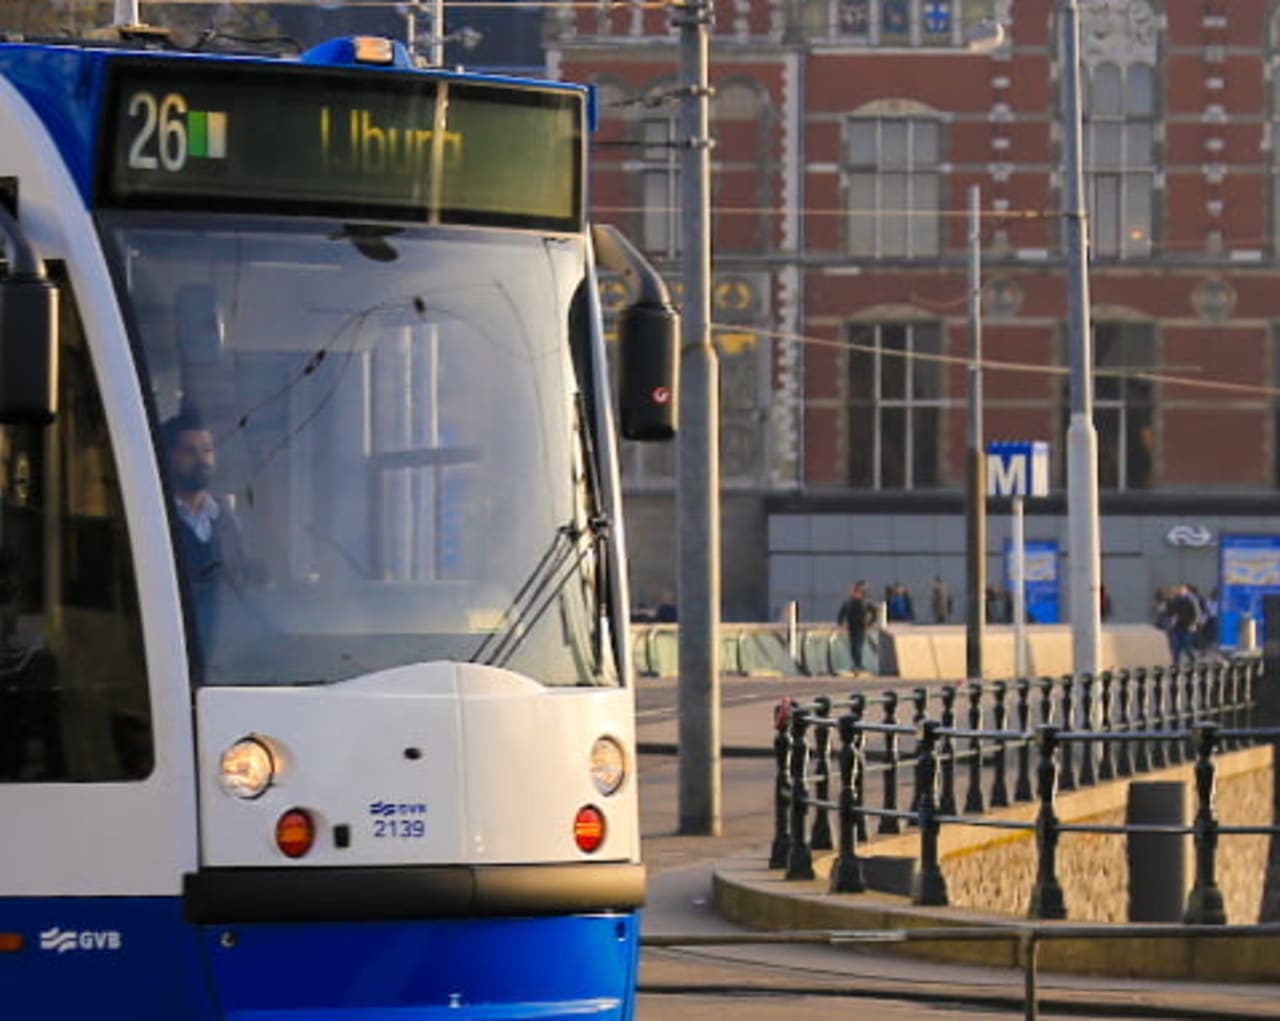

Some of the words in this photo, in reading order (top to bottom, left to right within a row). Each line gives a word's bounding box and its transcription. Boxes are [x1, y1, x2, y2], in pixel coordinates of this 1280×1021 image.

[128, 92, 187, 171] 26
[373, 819, 425, 838] 2139
[79, 931, 122, 950] GVB
